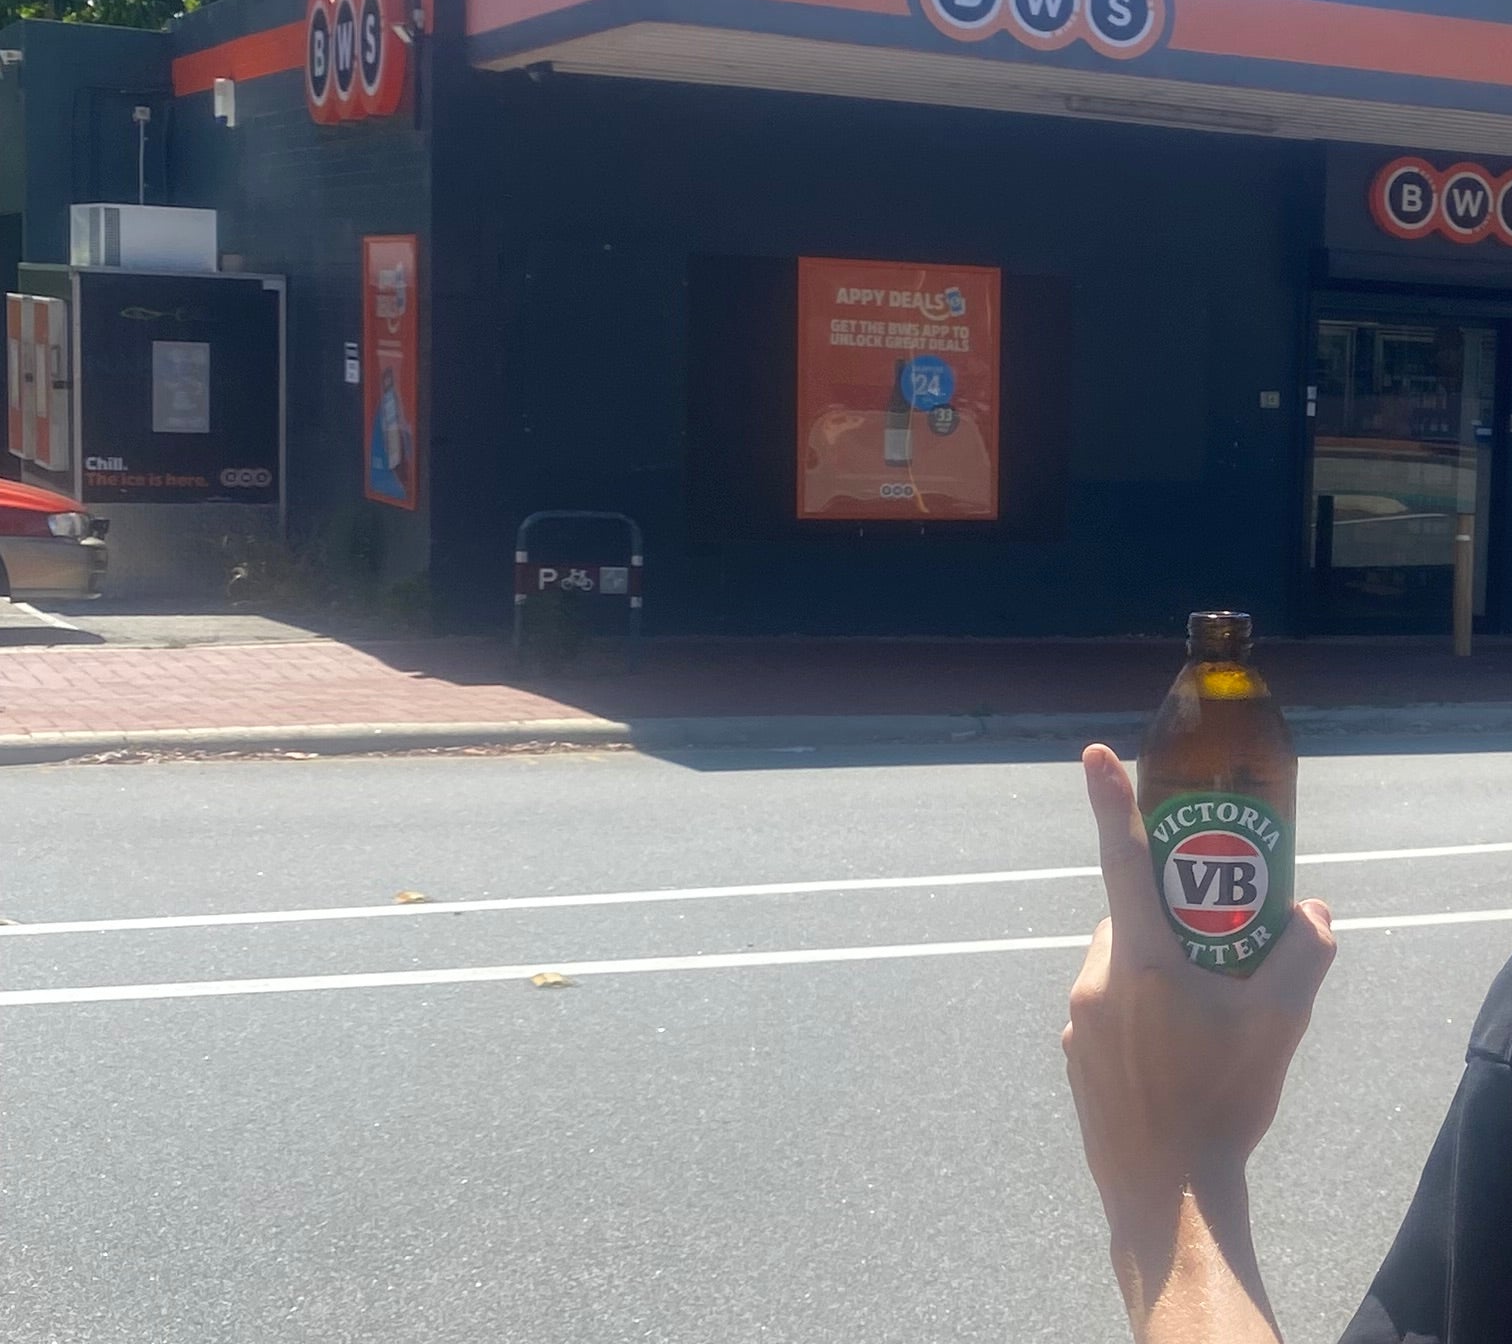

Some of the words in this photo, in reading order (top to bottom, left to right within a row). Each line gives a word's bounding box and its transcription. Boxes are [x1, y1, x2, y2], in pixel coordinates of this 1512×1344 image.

[313, 13, 376, 78] BWS
[836, 287, 885, 306] APPY
[889, 290, 945, 310] DEALS
[830, 319, 857, 333] GET
[859, 320, 885, 334] THE
[887, 322, 919, 336] BWS
[921, 324, 949, 338] APP
[952, 326, 969, 339] TO
[830, 333, 882, 347] UNLOCK
[885, 336, 926, 349] GREAT
[929, 338, 969, 352] DEALS
[85, 457, 128, 471] Chill.
[538, 568, 558, 590] P
[1153, 802, 1280, 852] VICTORIA
[1173, 858, 1258, 906] VB
[1185, 925, 1272, 965] TTER
